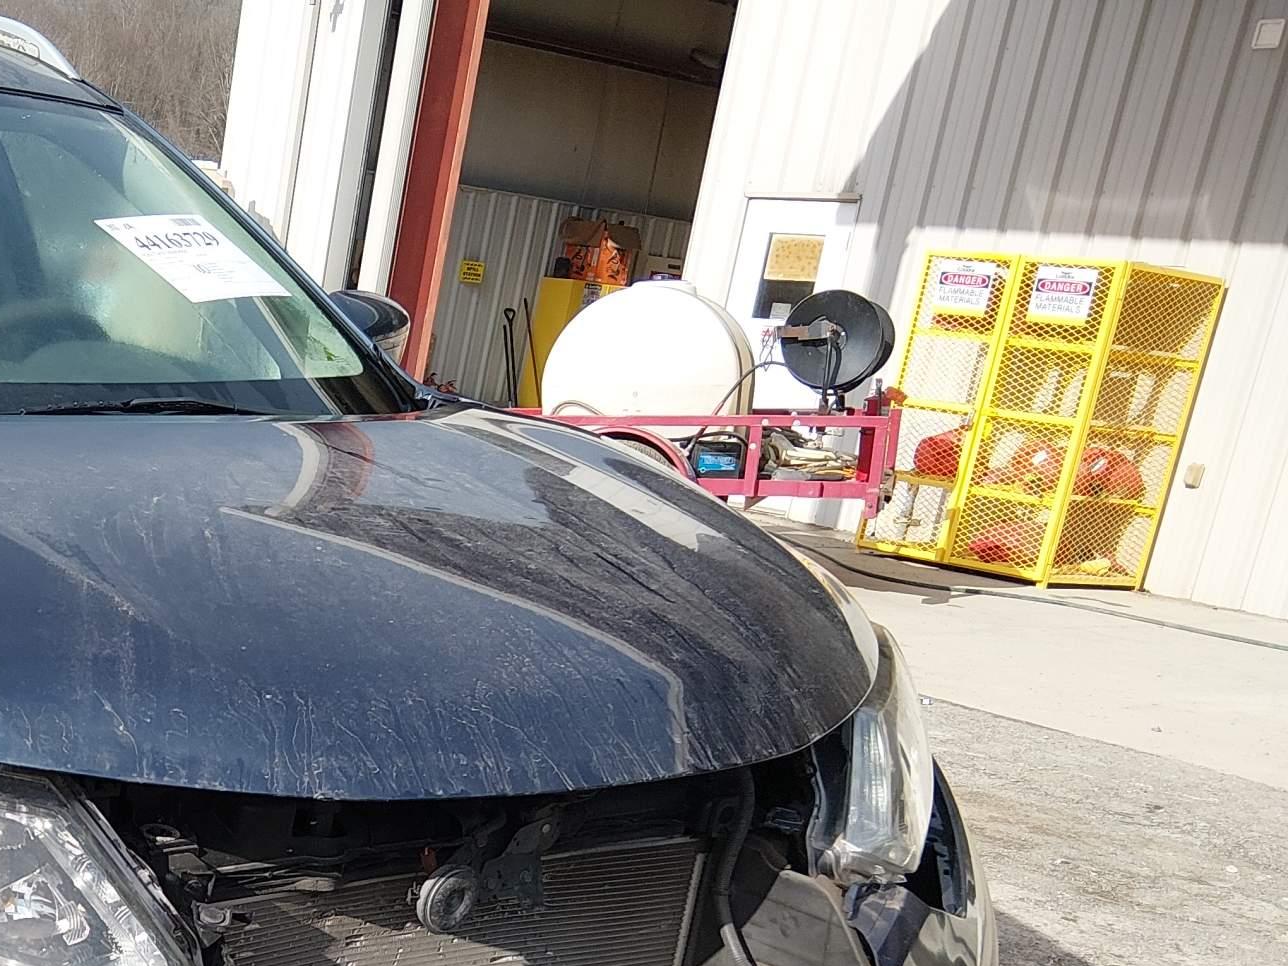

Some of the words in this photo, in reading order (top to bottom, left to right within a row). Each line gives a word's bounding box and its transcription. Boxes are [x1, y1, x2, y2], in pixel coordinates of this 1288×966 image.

[134, 231, 220, 251] 44163729
[947, 273, 983, 286] DANGER
[938, 286, 984, 298] FLAMMABLE
[1044, 281, 1084, 294] DANGER
[938, 295, 980, 306] MATERIALS
[1034, 293, 1086, 306] FLAMMABLE
[1035, 302, 1081, 314] MATERIALS
